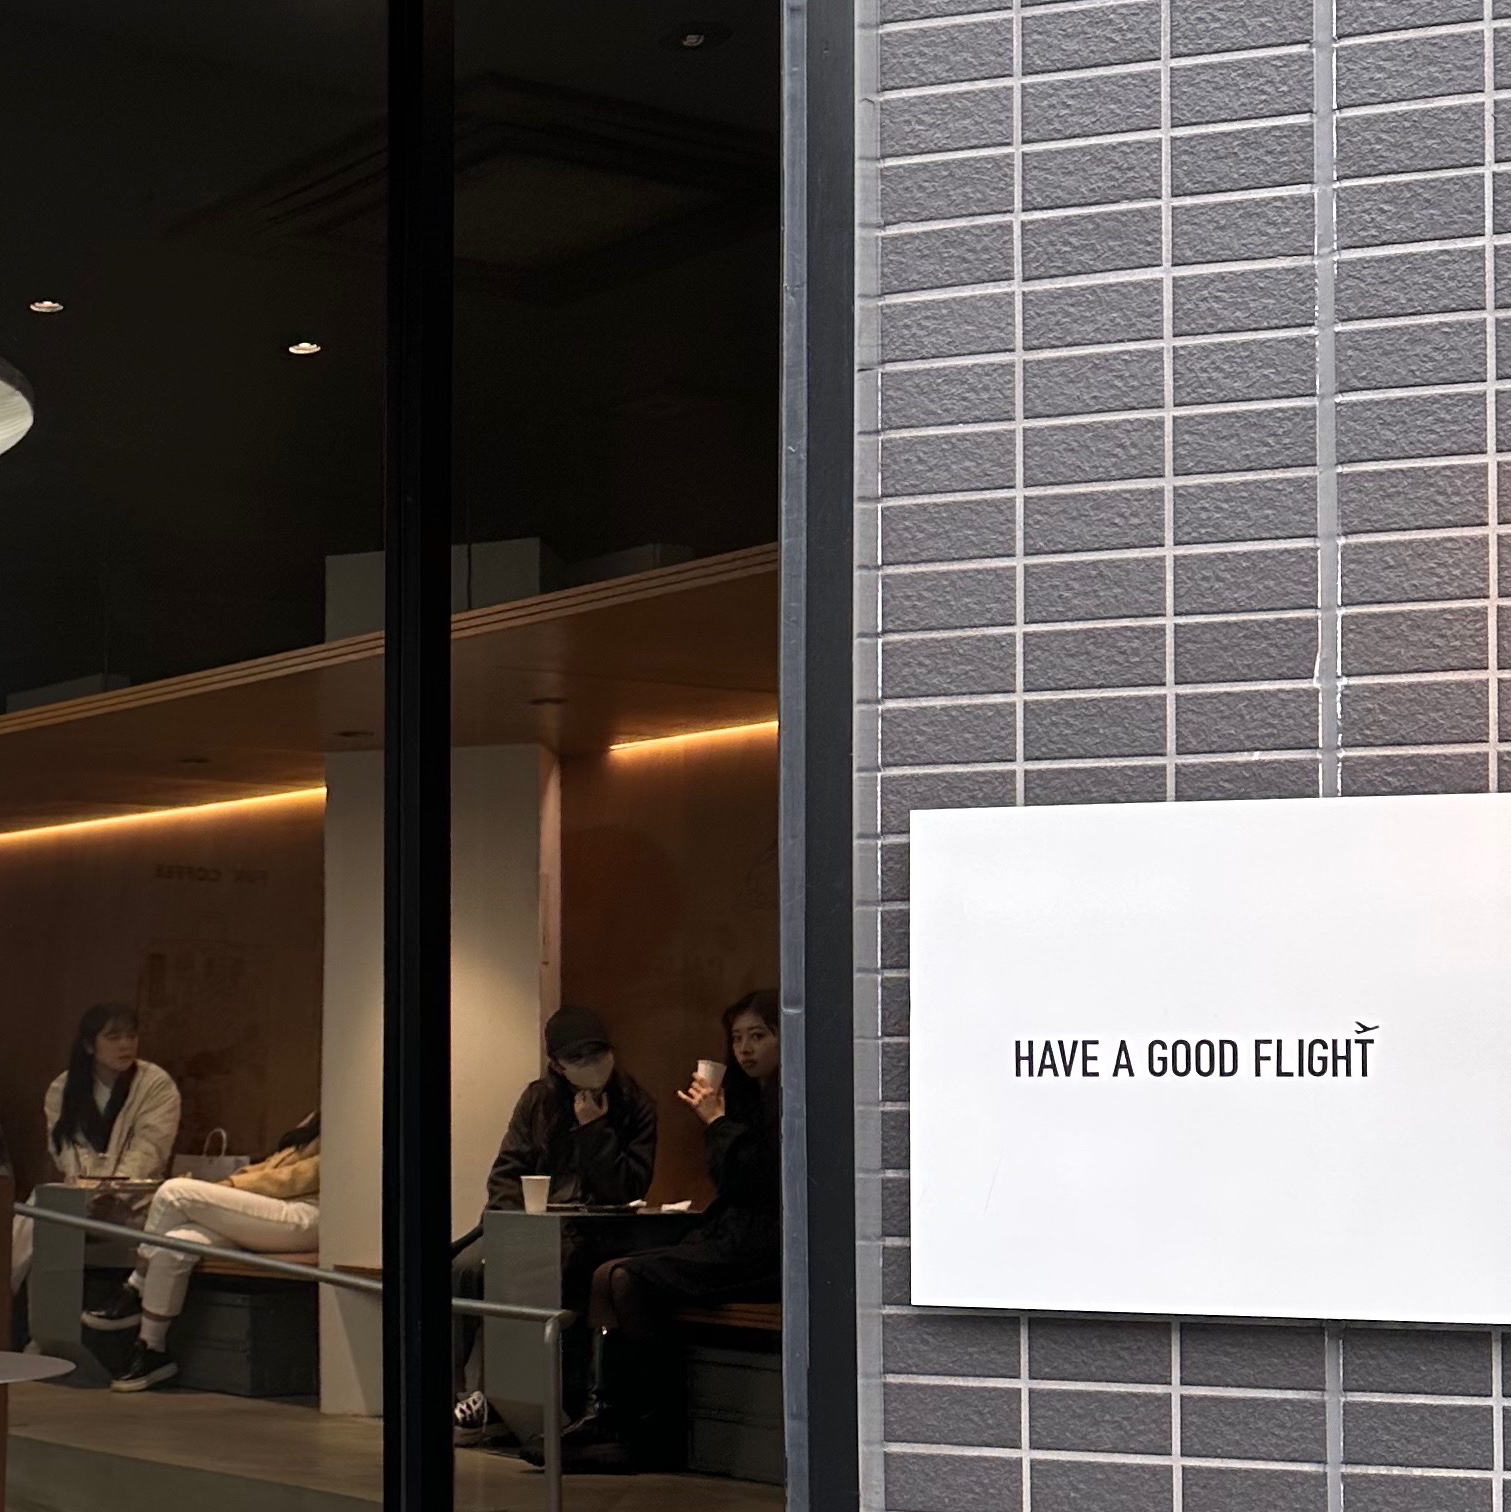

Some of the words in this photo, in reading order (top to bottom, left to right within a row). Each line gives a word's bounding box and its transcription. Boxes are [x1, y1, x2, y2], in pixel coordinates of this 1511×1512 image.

[1015, 1040, 1099, 1077] HAVE
[1112, 1040, 1135, 1077] A
[1148, 1039, 1238, 1077] GOOD
[1255, 1039, 1374, 1077] FLIGHT
